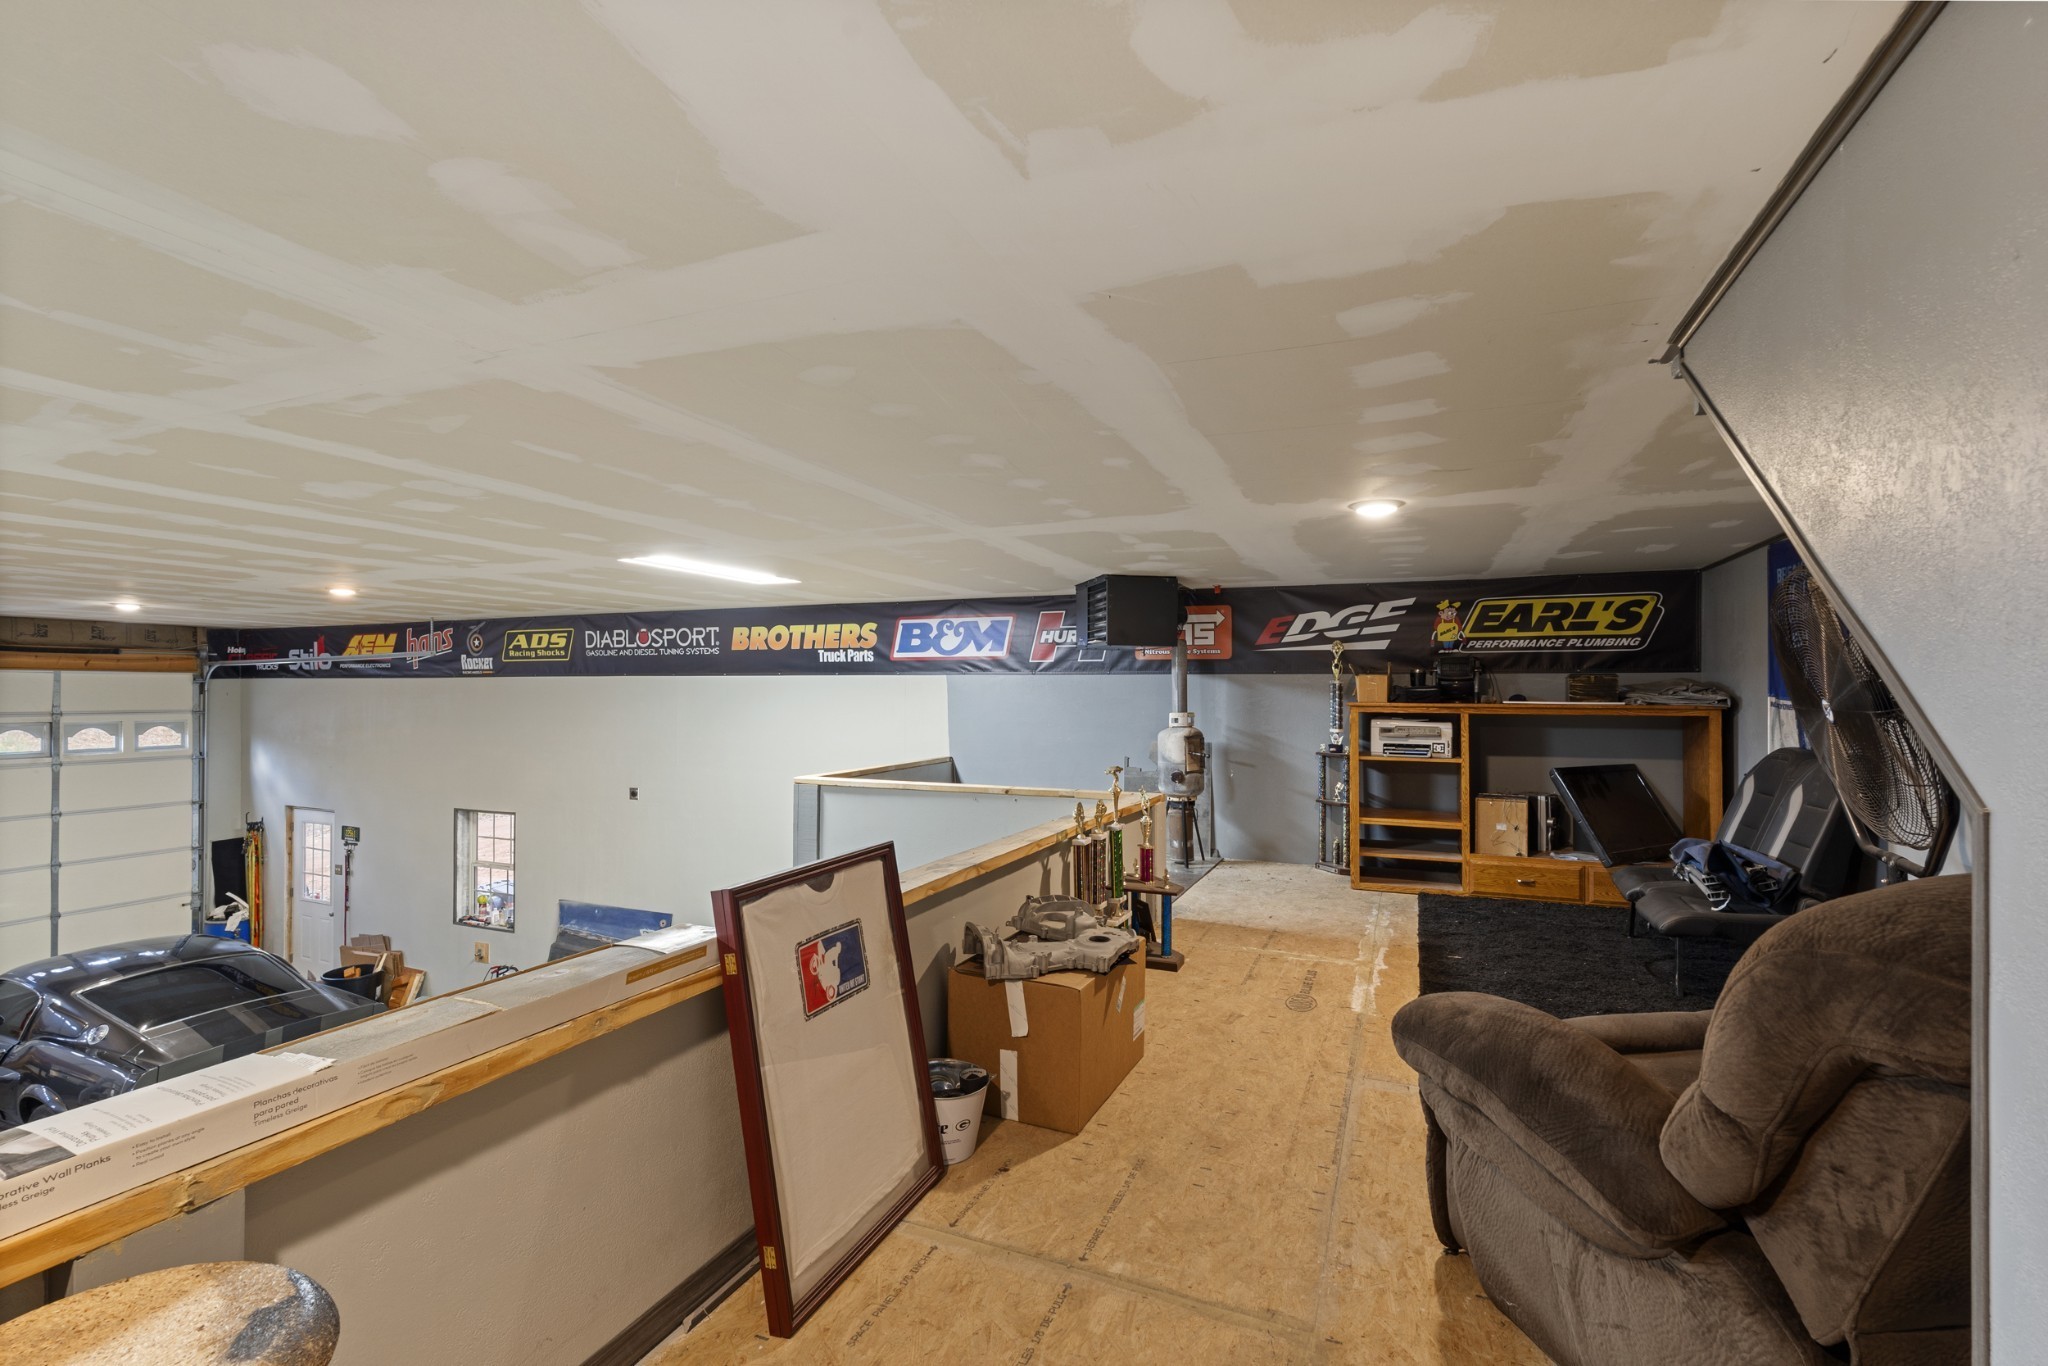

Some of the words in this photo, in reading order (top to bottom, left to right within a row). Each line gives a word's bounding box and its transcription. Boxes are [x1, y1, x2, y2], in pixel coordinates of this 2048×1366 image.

[1255, 597, 1417, 646] EDGE
[1469, 599, 1650, 634] EARL'S
[508, 632, 568, 649] ADS
[731, 622, 878, 650] BROTHERS
[896, 619, 1010, 656] B&M
[1040, 630, 1077, 643] HUR
[1466, 638, 1566, 648] PERFORMANCE
[1567, 637, 1642, 647] PLUMBING
[288, 637, 332, 670] Stilo
[509, 650, 536, 658] Racing
[619, 648, 634, 656] AND
[634, 648, 658, 656] DIESEL
[660, 648, 685, 656] TUNING
[685, 647, 720, 655] SYSTEMS
[818, 649, 847, 663] Truck
[847, 649, 874, 662] Parts
[253, 1091, 291, 1109] Planchas
[292, 1075, 338, 1094] decorativas
[253, 1107, 274, 1120] para
[275, 1097, 299, 1113] pared
[253, 1112, 284, 1127] Timeless
[285, 1103, 308, 1116] Greige
[0, 1181, 40, 1200] orative
[42, 1168, 72, 1184] Wall
[74, 1155, 112, 1174] Planks
[0, 1199, 19, 1210] less
[21, 1186, 55, 1203] Greige
[846, 1320, 875, 1348] SPACE
[872, 1288, 902, 1318] PANELS
[909, 1255, 931, 1274] INCH
[1040, 1315, 1054, 1328] DE
[1047, 1293, 1067, 1315] PULG
